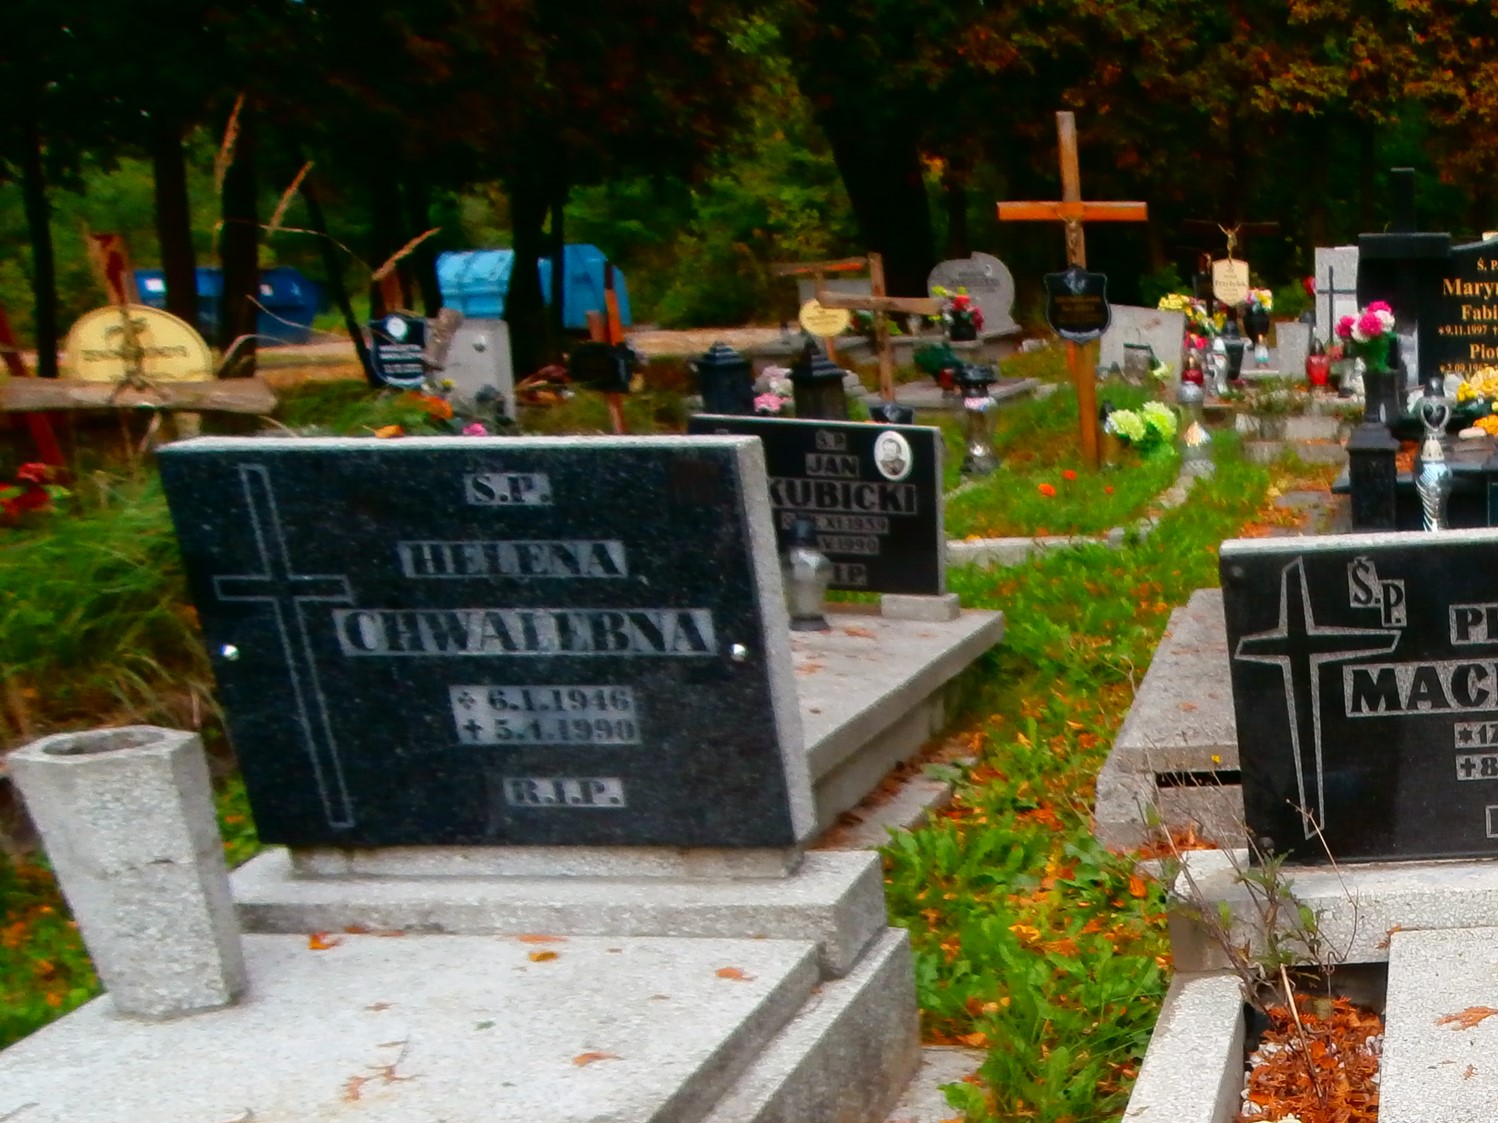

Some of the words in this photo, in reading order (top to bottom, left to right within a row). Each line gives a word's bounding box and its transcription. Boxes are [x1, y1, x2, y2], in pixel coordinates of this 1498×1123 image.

[807, 455, 858, 476] JAN
[408, 542, 623, 576] HELENA
[343, 612, 714, 653] CHWALEBNA
[513, 779, 622, 806] R.I.P.
